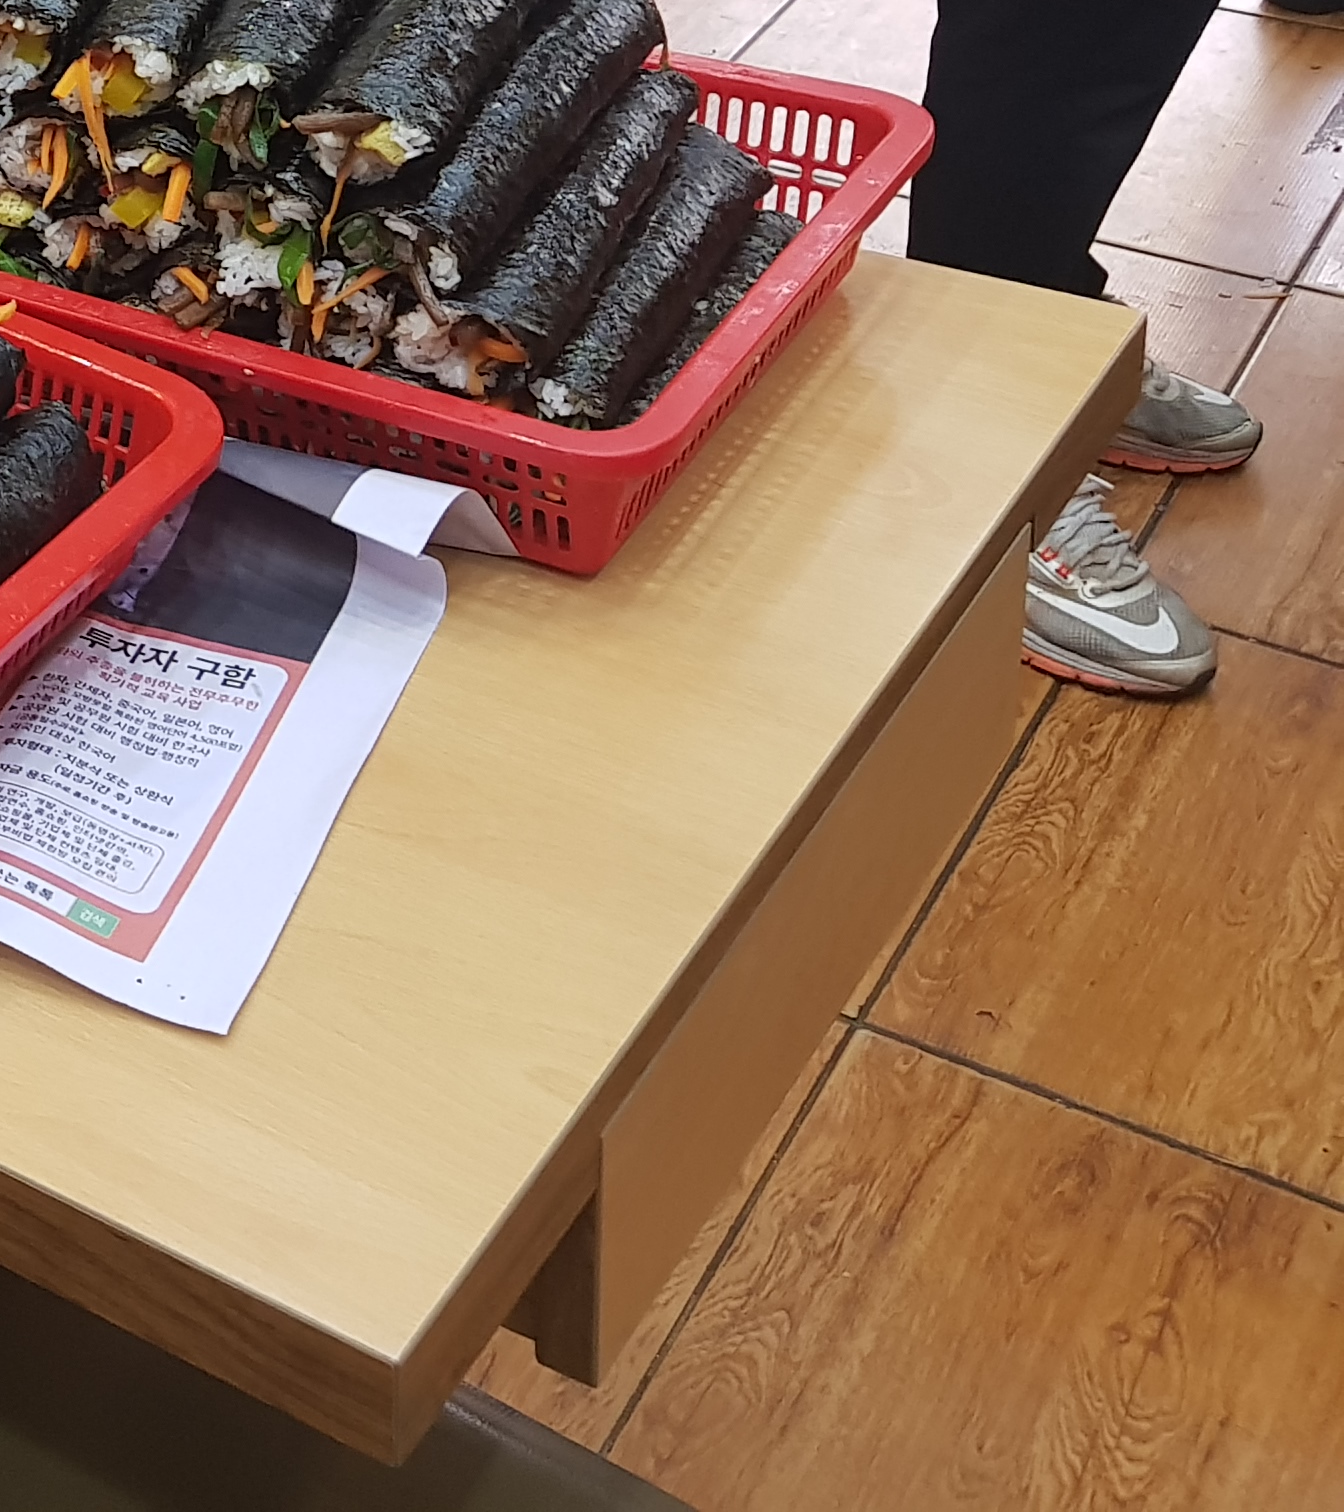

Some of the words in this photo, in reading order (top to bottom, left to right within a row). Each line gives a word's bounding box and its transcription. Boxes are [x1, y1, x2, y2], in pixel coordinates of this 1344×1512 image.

[80, 628, 178, 673] 투자자
[187, 657, 256, 689] 구함
[172, 696, 202, 711] 사업
[78, 740, 116, 763] 한국어
[103, 772, 129, 789] 또는
